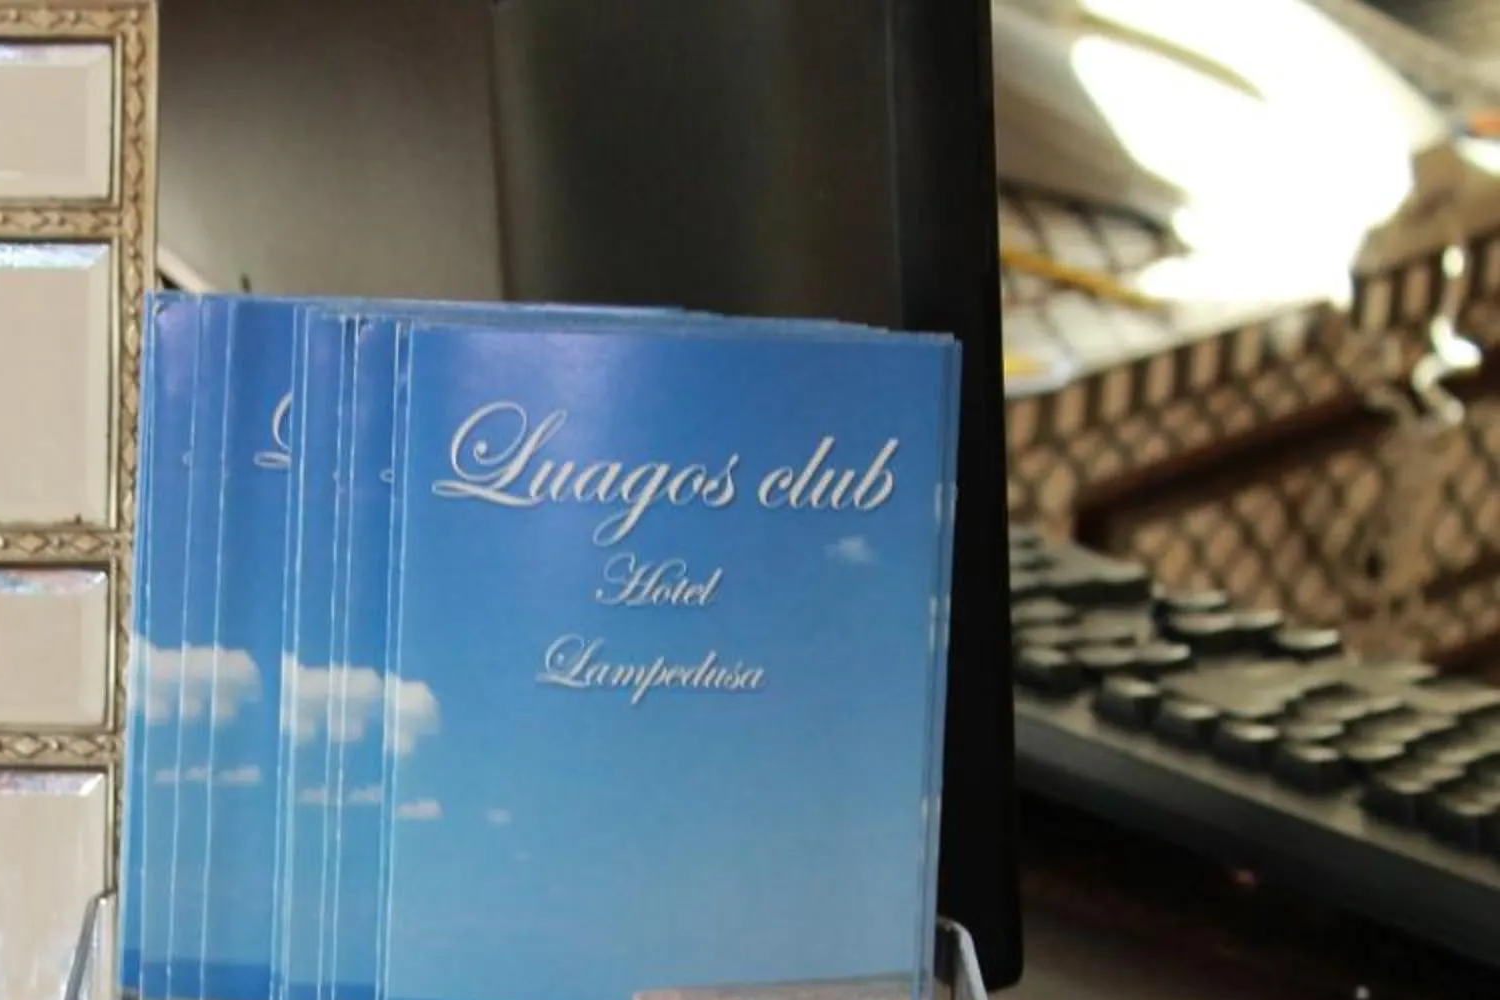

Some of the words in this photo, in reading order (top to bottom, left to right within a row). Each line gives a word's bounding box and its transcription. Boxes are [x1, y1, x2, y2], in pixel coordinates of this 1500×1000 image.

[431, 399, 741, 548] Luagos
[757, 434, 900, 512] club
[594, 551, 723, 608] Hotel
[536, 633, 767, 705] Lampedusa
